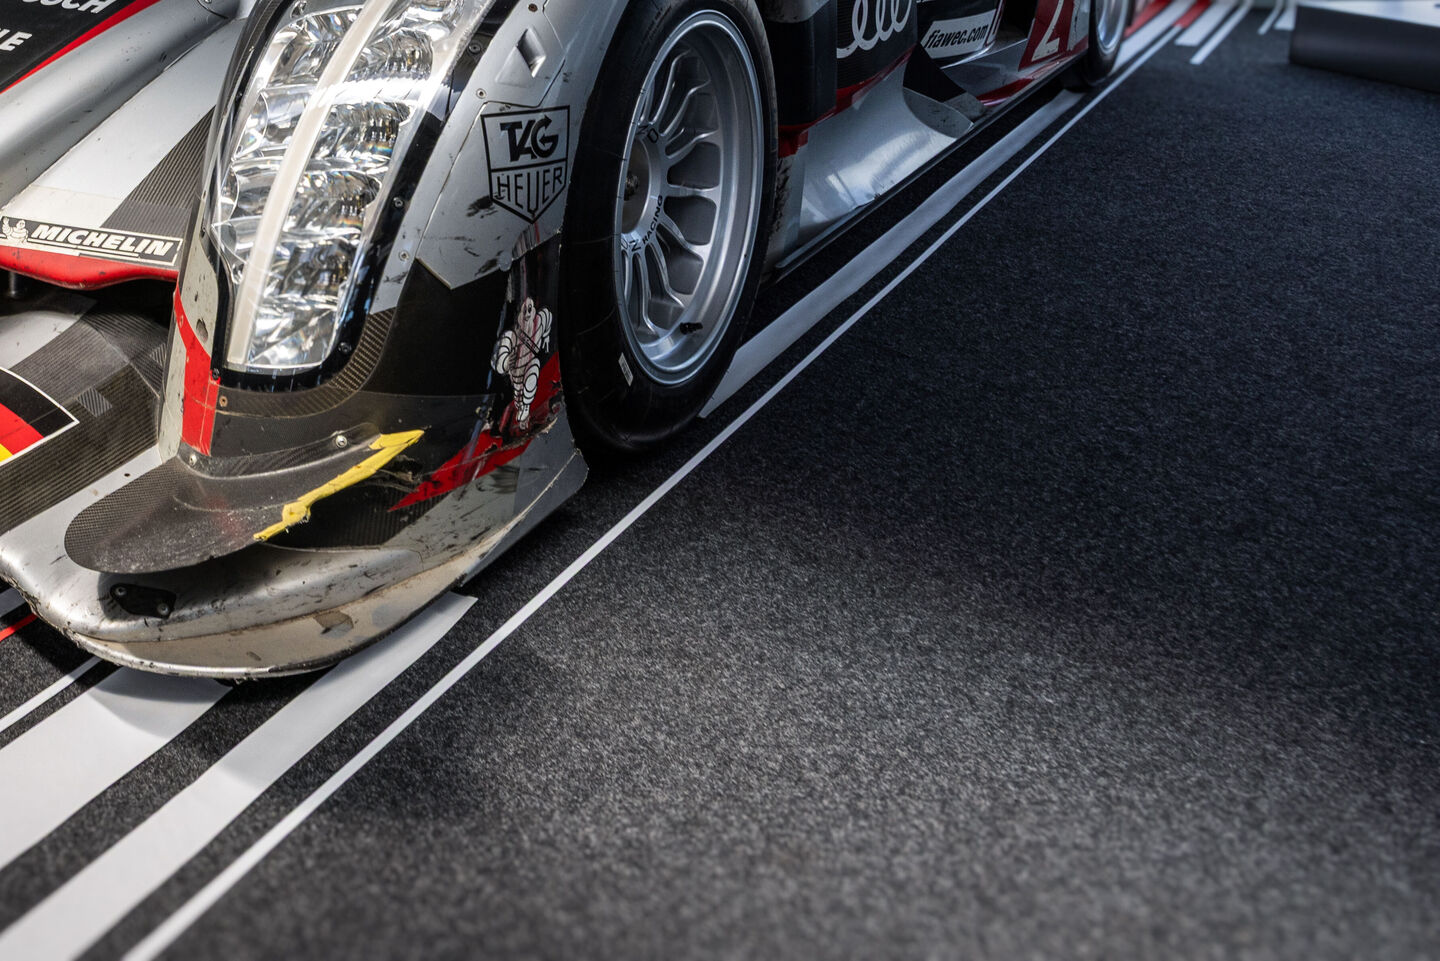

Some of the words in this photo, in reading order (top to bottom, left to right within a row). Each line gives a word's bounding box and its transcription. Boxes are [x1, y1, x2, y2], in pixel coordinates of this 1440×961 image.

[923, 23, 990, 49] fiawec.com
[499, 114, 560, 162] TAG
[496, 167, 563, 215] HEUER
[31, 224, 174, 257] MICHELIN
